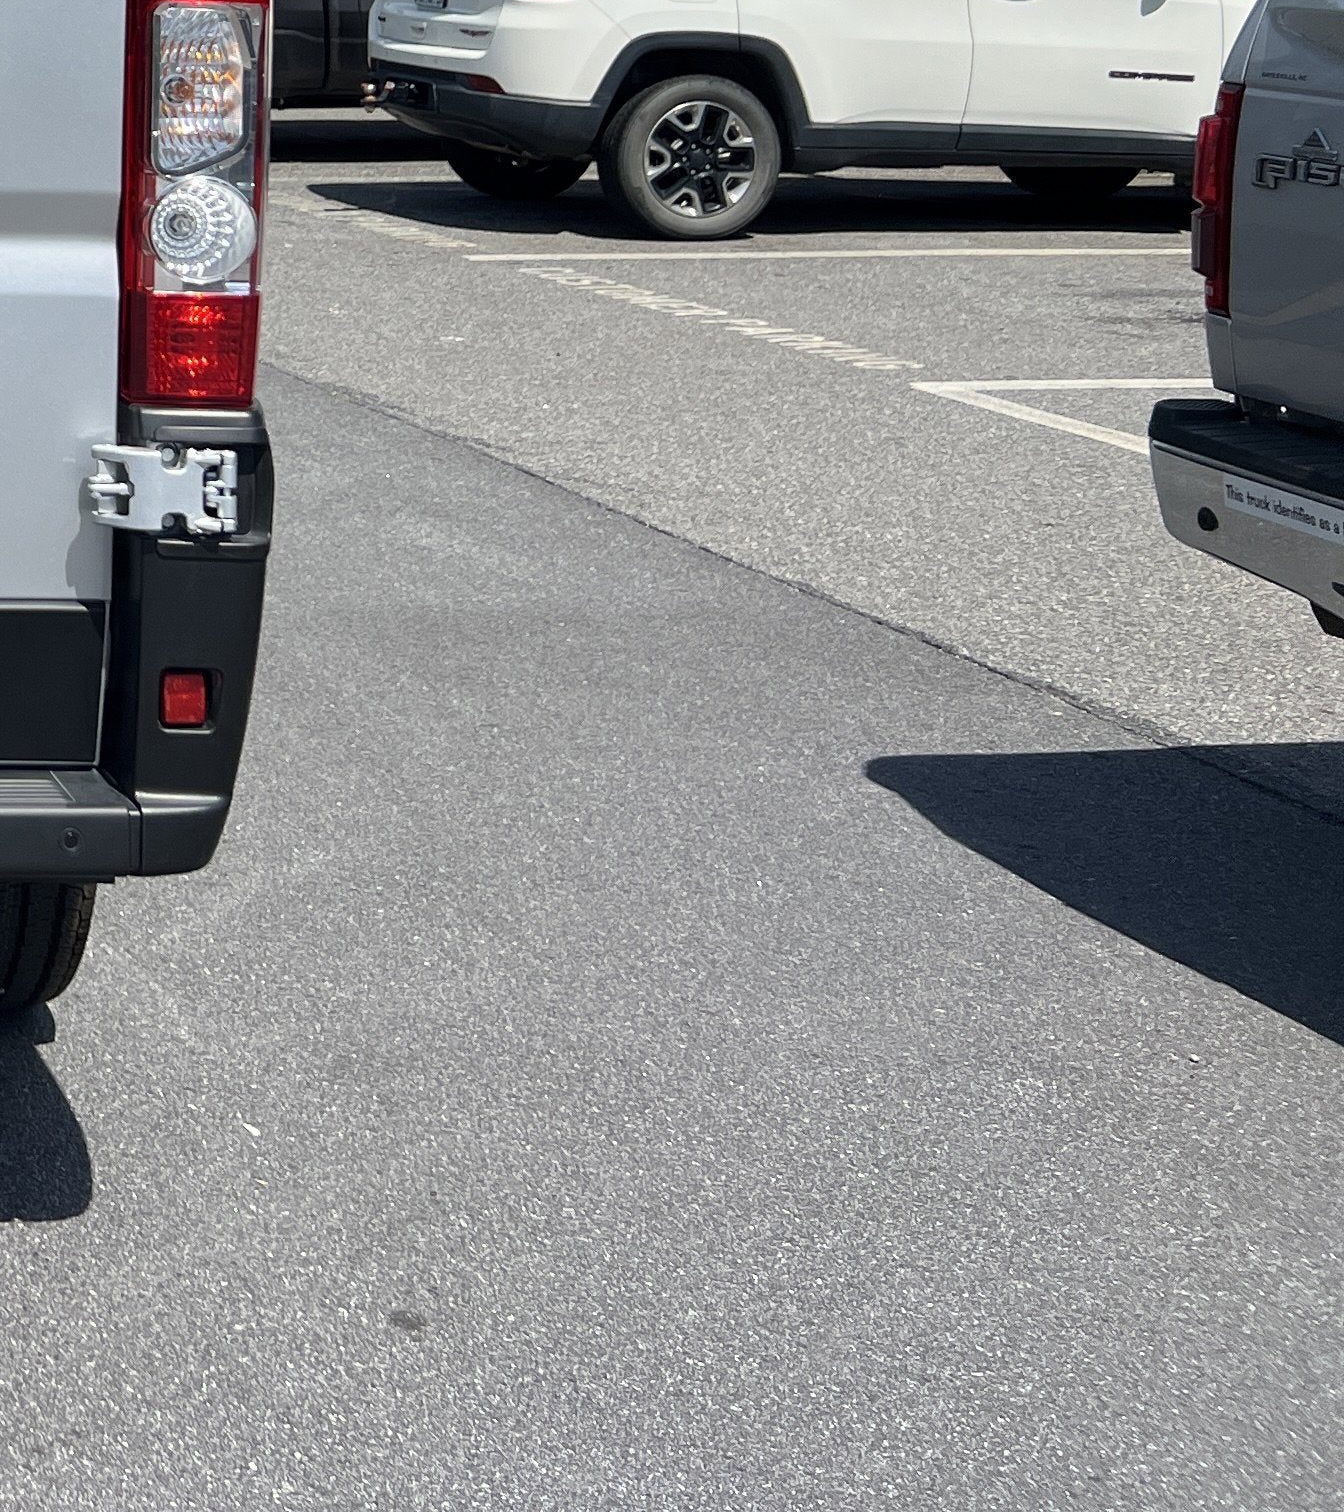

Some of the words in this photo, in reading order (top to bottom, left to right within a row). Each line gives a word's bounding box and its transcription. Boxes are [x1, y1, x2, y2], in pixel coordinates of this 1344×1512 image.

[1252, 152, 1344, 189] F15
[1225, 484, 1244, 503] This
[1247, 491, 1271, 512] truck
[1273, 499, 1316, 527] identifies
[1319, 518, 1331, 531] as
[1333, 522, 1340, 535] a
